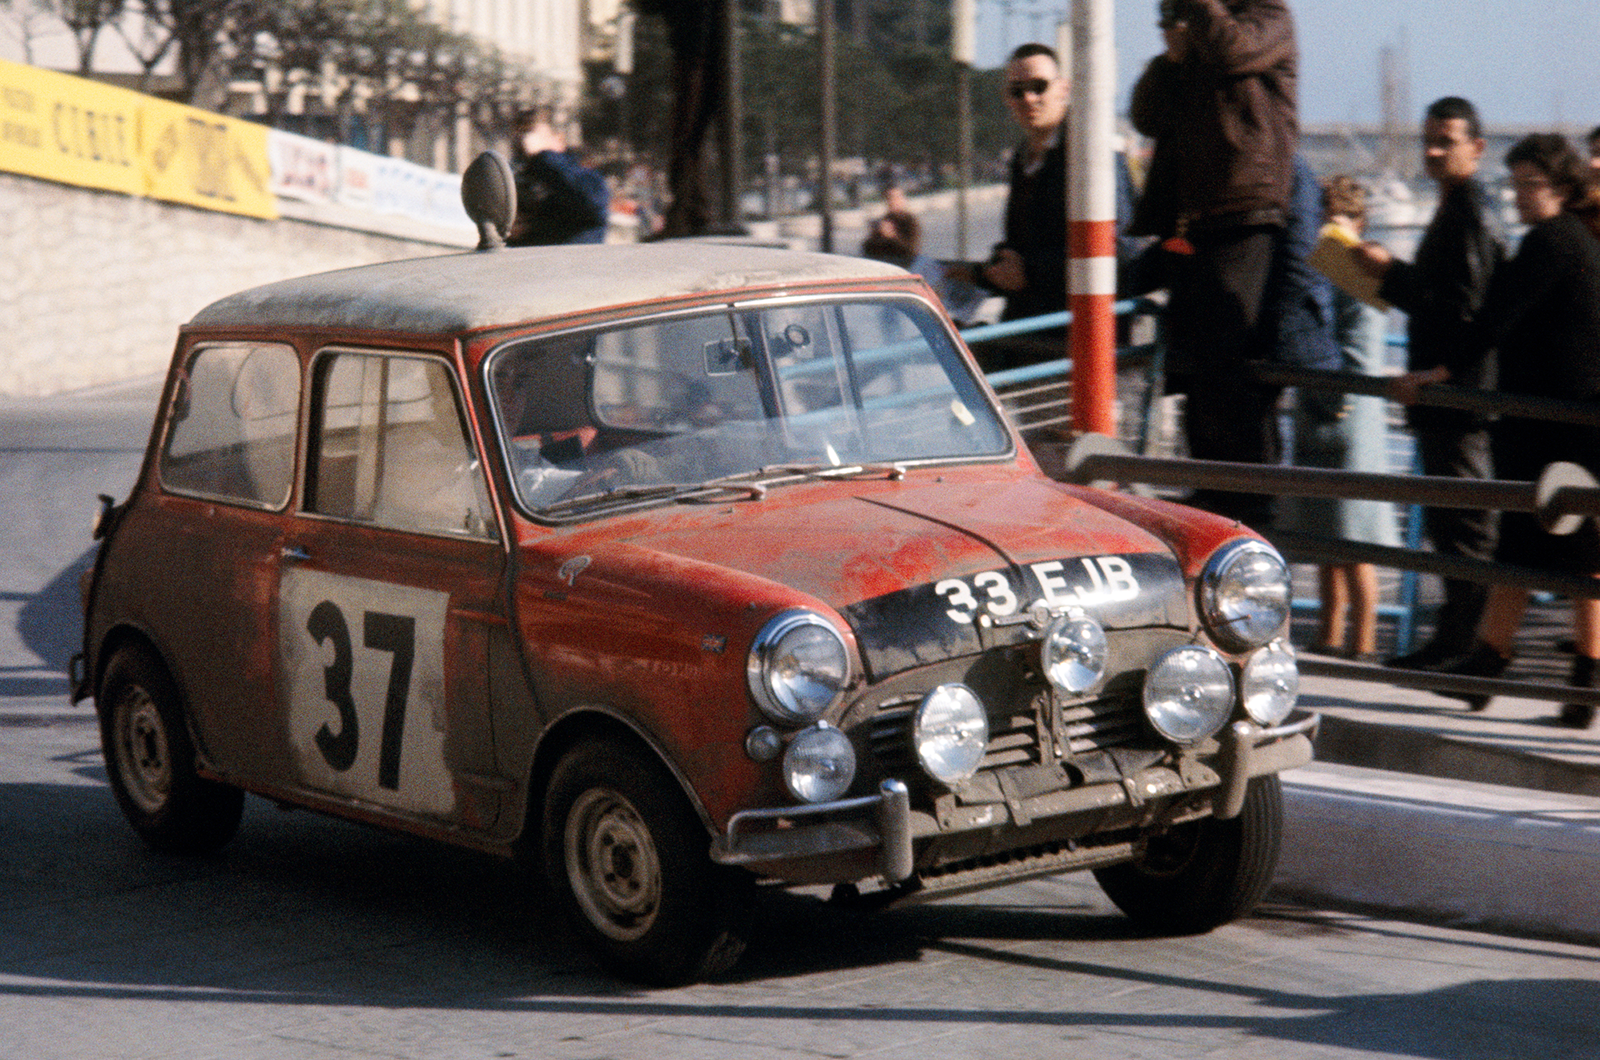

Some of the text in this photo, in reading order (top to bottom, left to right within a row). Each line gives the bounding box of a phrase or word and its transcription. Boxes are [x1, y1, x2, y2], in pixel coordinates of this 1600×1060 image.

[935, 556, 1140, 624] 33 EJB
[306, 600, 416, 791] 37
